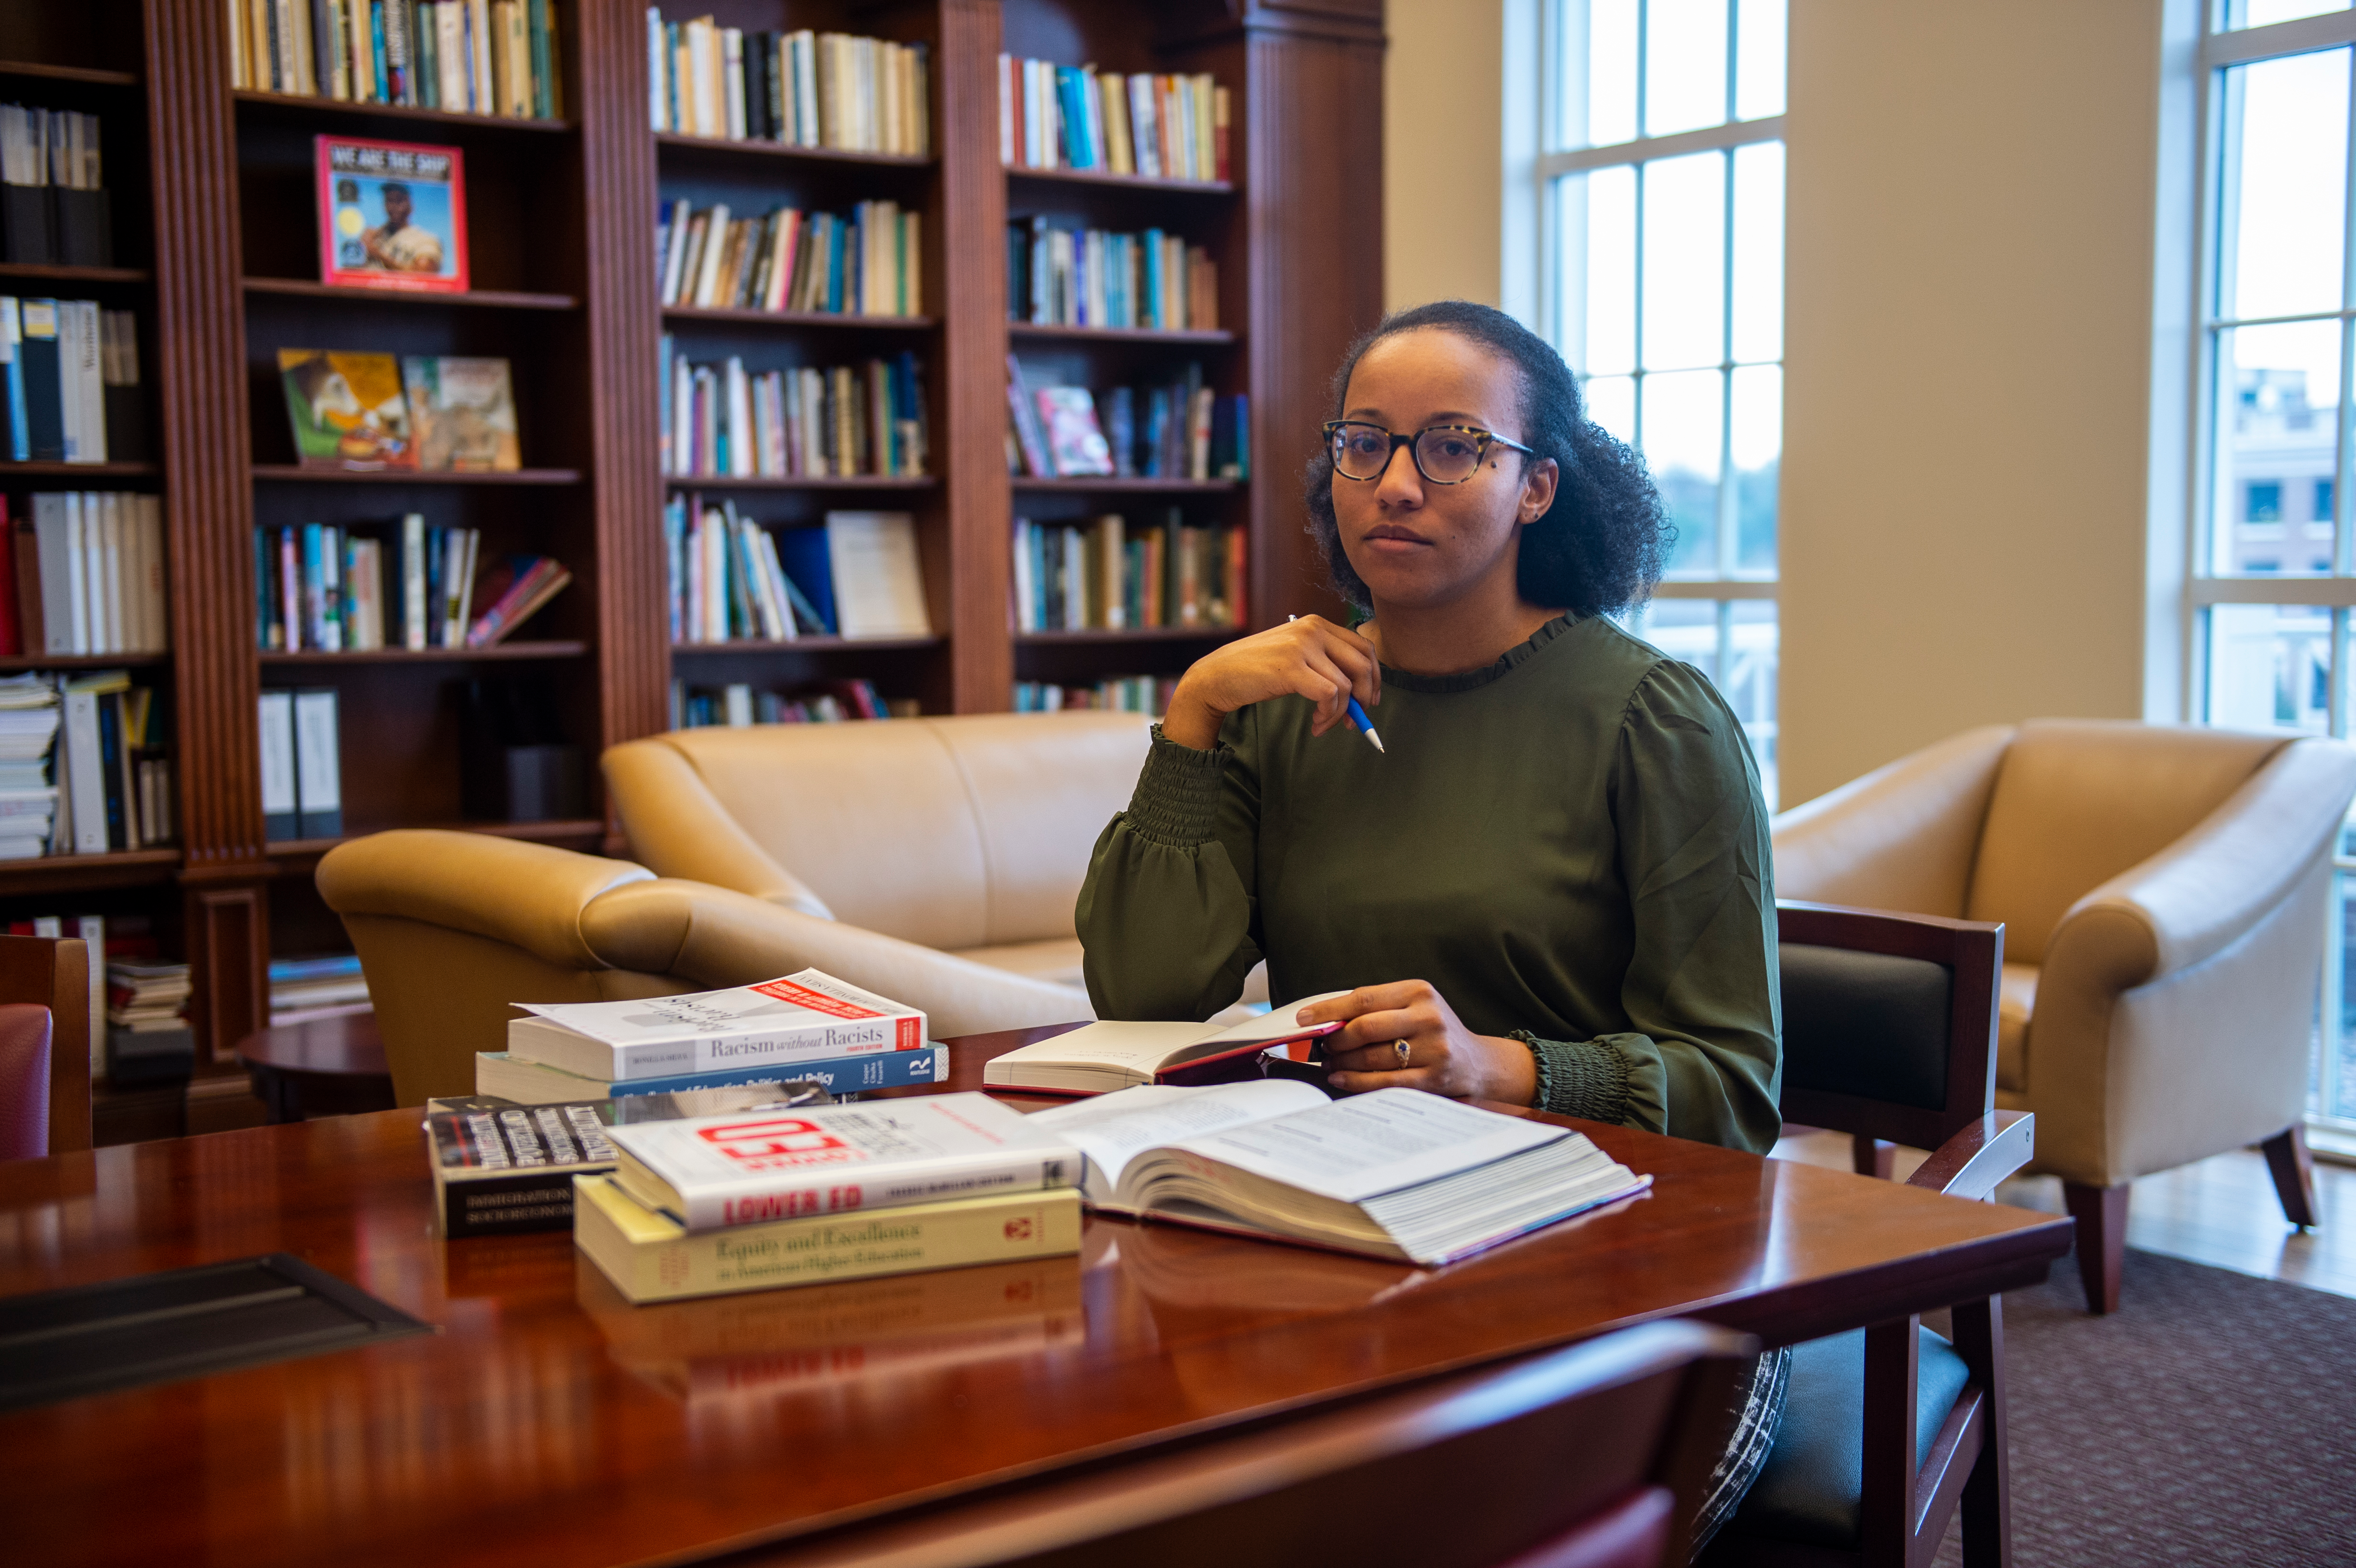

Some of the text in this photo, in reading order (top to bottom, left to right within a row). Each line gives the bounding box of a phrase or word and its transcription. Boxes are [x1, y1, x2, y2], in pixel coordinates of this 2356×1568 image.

[711, 1026, 883, 1058] Racism without Racists
[806, 1071, 834, 1086] Policy
[723, 1187, 818, 1226] LOWER
[829, 1185, 862, 1211] ED
[717, 1221, 921, 1261] Equity and Excellence
